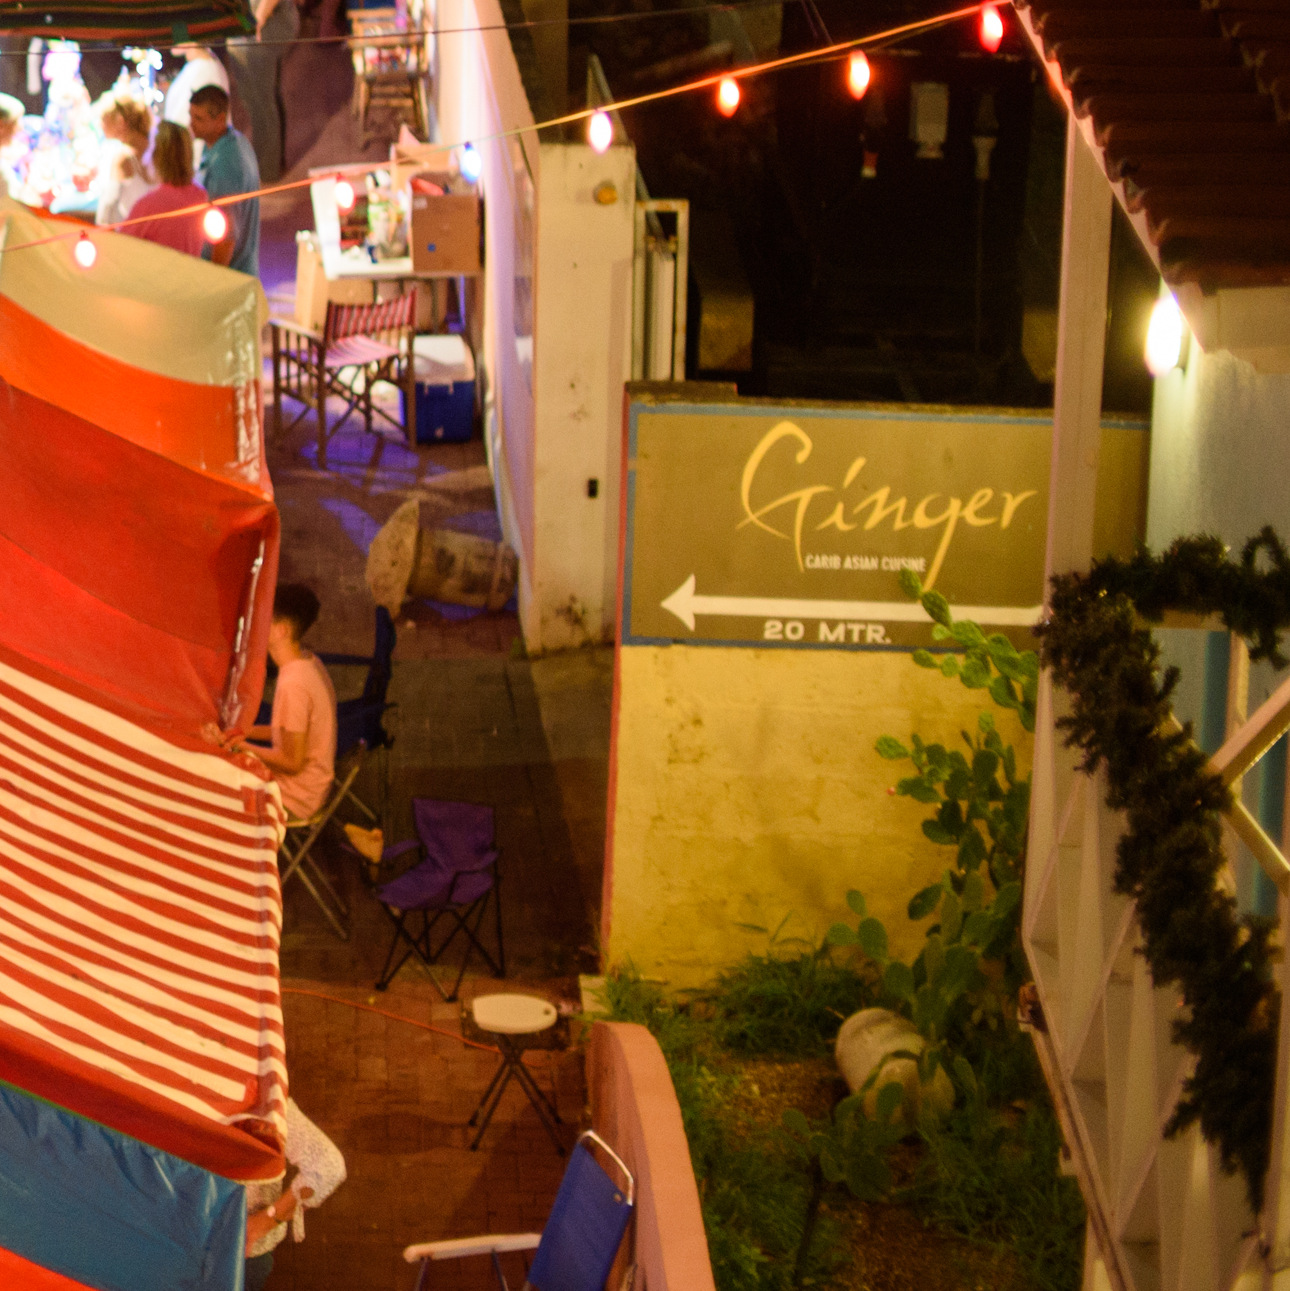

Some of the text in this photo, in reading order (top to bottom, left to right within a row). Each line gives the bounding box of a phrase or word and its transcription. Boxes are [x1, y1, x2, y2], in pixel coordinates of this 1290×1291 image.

[735, 420, 1038, 593] Ginger
[805, 553, 927, 574] CARIB ASIAN CUISINE
[762, 620, 893, 645] 20 MTR.
